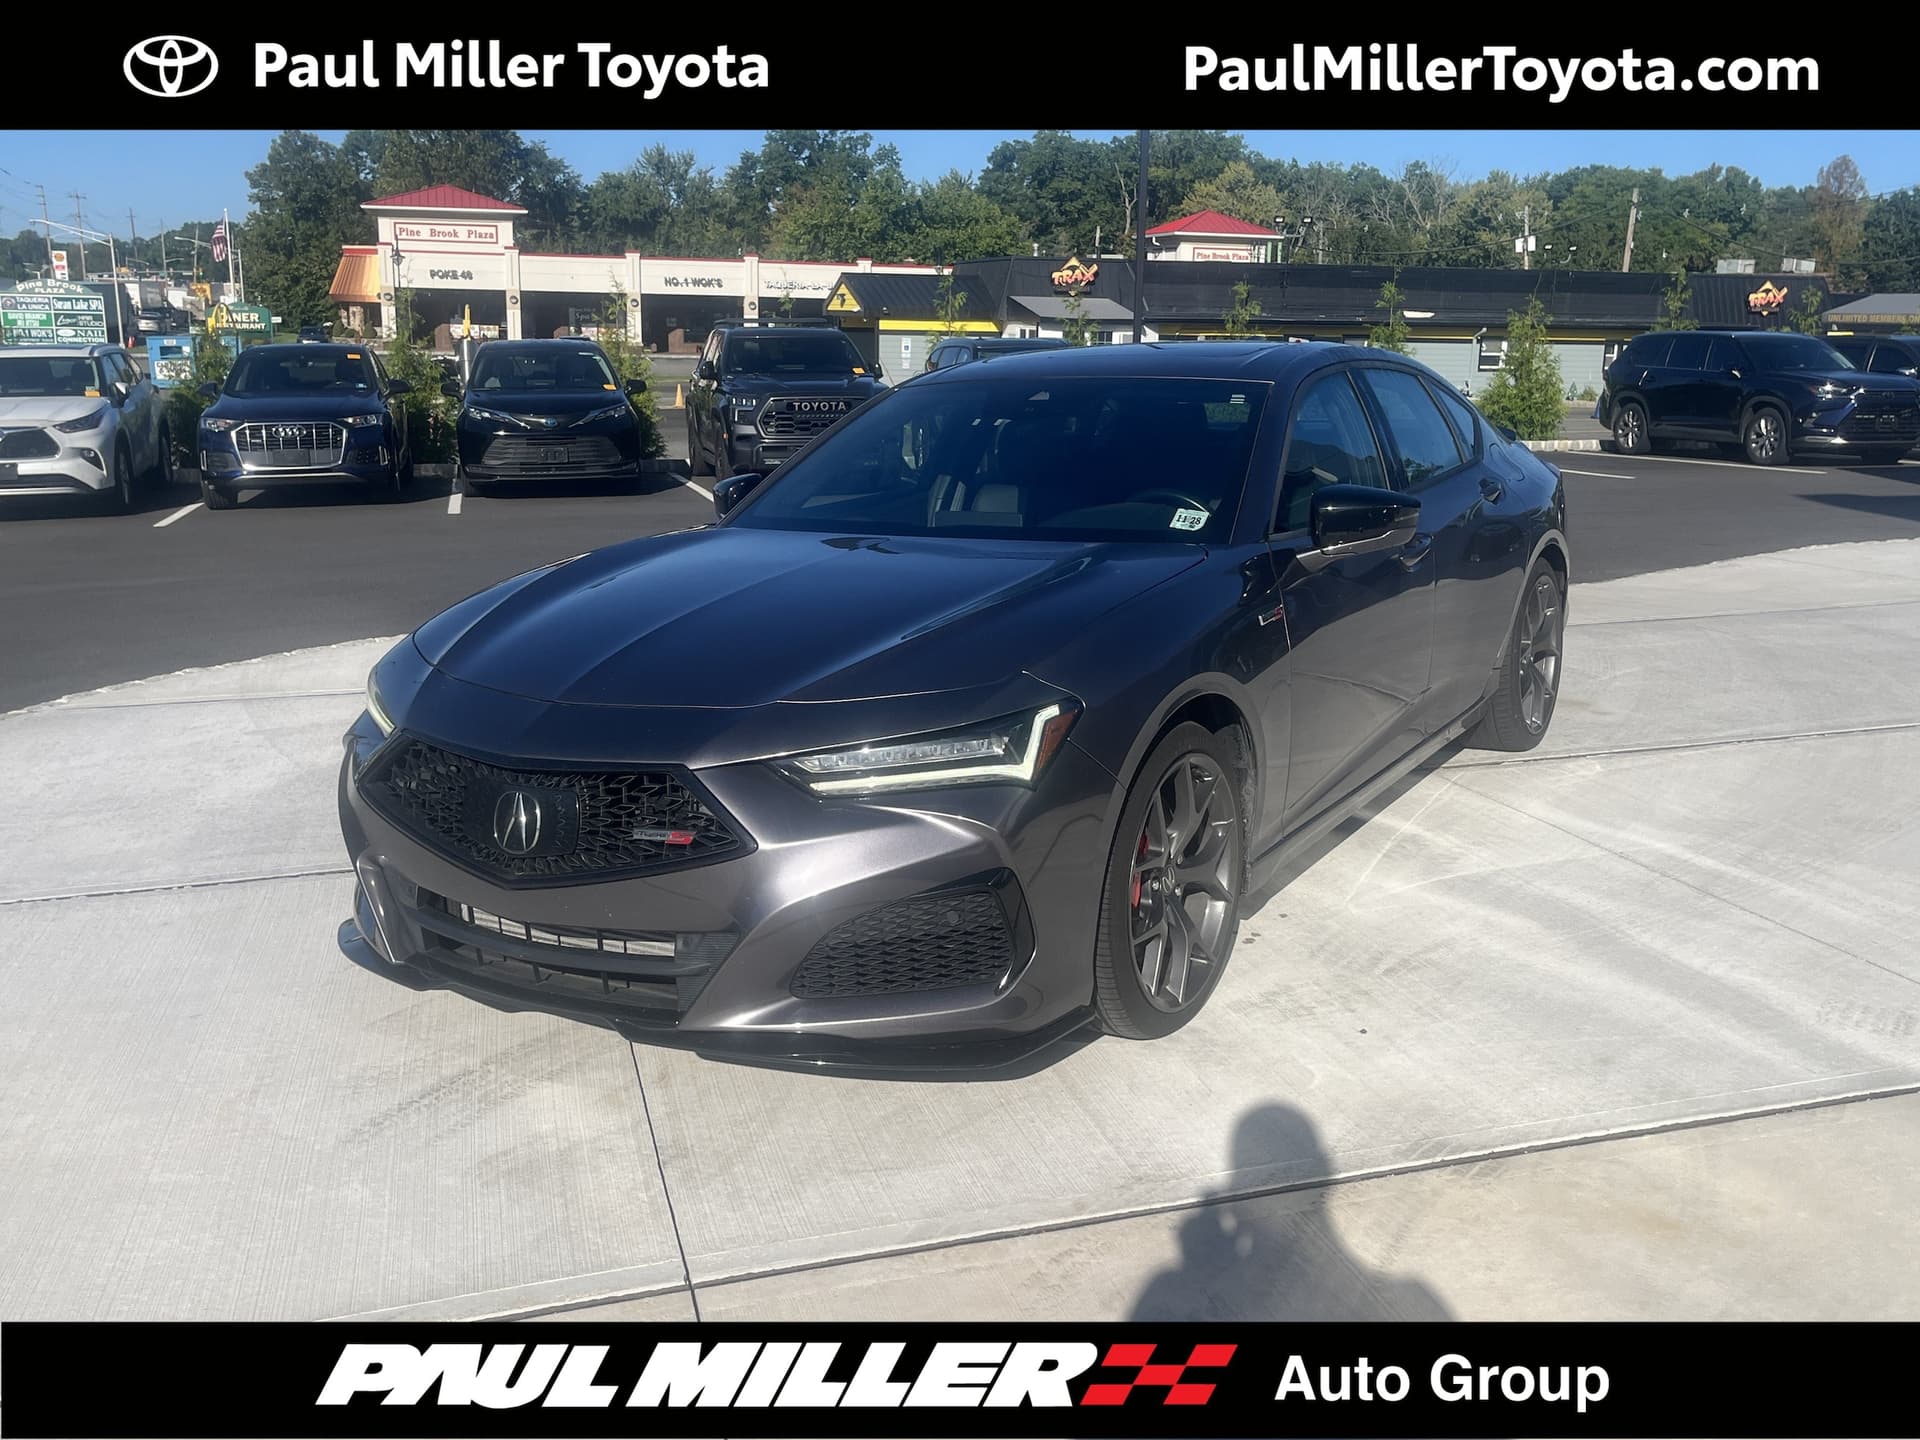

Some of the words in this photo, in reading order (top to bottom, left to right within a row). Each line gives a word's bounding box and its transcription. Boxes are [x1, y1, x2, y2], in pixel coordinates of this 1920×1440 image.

[399, 227, 421, 237] Pine
[430, 229, 459, 239] Brook
[467, 230, 494, 239] Plaza
[429, 269, 459, 280] POKE
[460, 270, 473, 280] 48
[1052, 263, 1098, 287] TRAX
[16, 280, 42, 292] Pine
[47, 279, 83, 293] Brook
[690, 277, 723, 289] WOK'S
[1749, 287, 1788, 308] TRAX
[89, 299, 104, 310] SPA
[793, 402, 847, 411] TOYOTA
